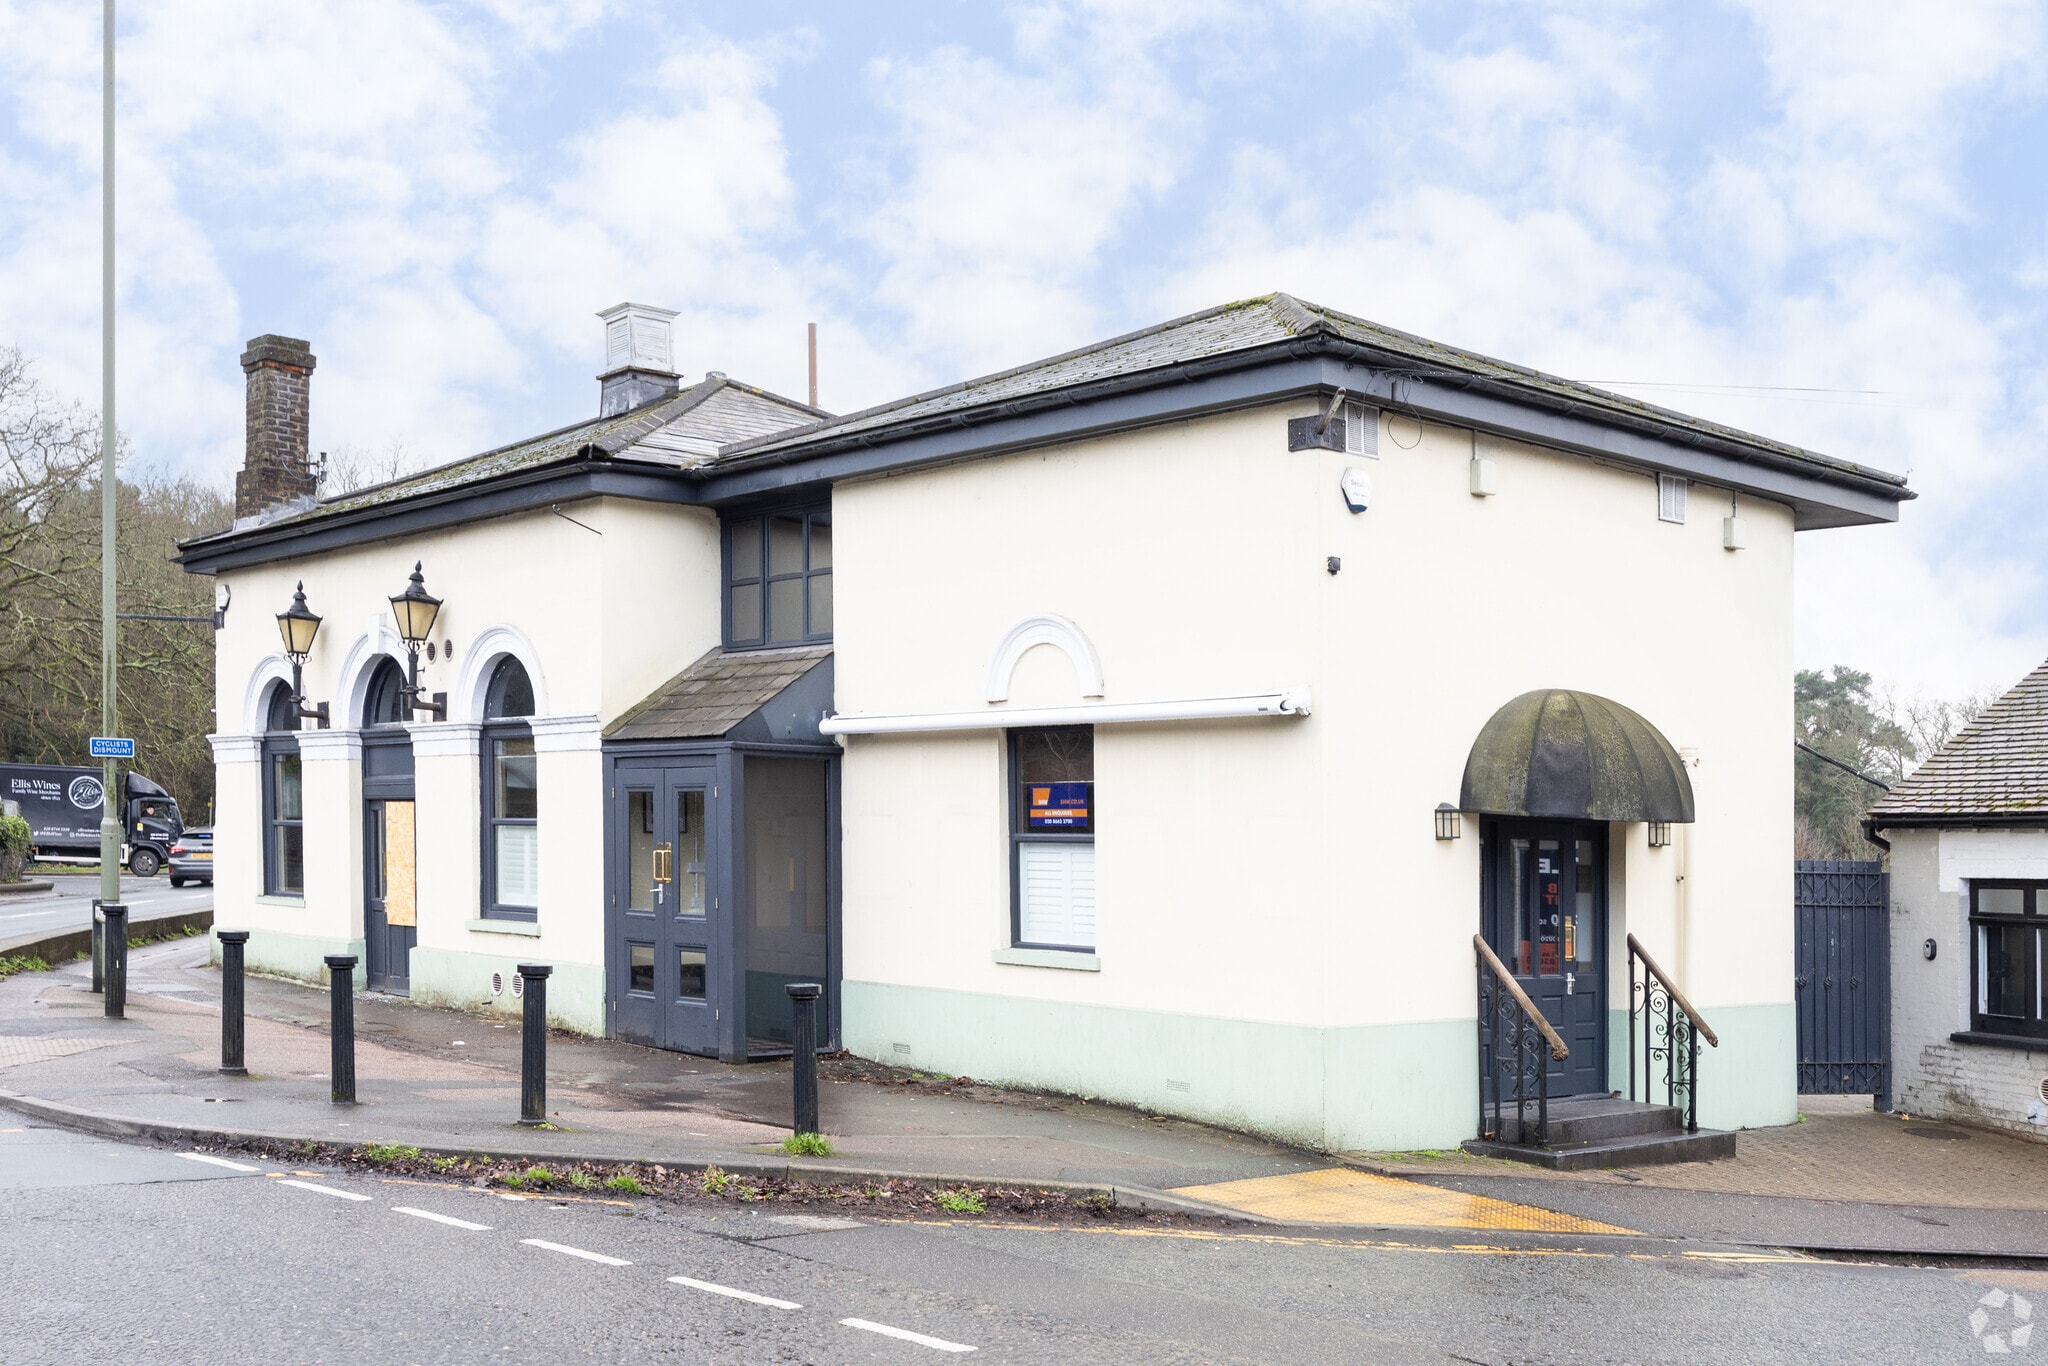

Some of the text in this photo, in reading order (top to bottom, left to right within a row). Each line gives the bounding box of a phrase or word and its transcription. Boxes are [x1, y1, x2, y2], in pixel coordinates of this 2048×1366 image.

[95, 740, 129, 748] CYCLISTS
[93, 746, 131, 755] DISMOUNT
[11, 778, 61, 790] Ellis Wines
